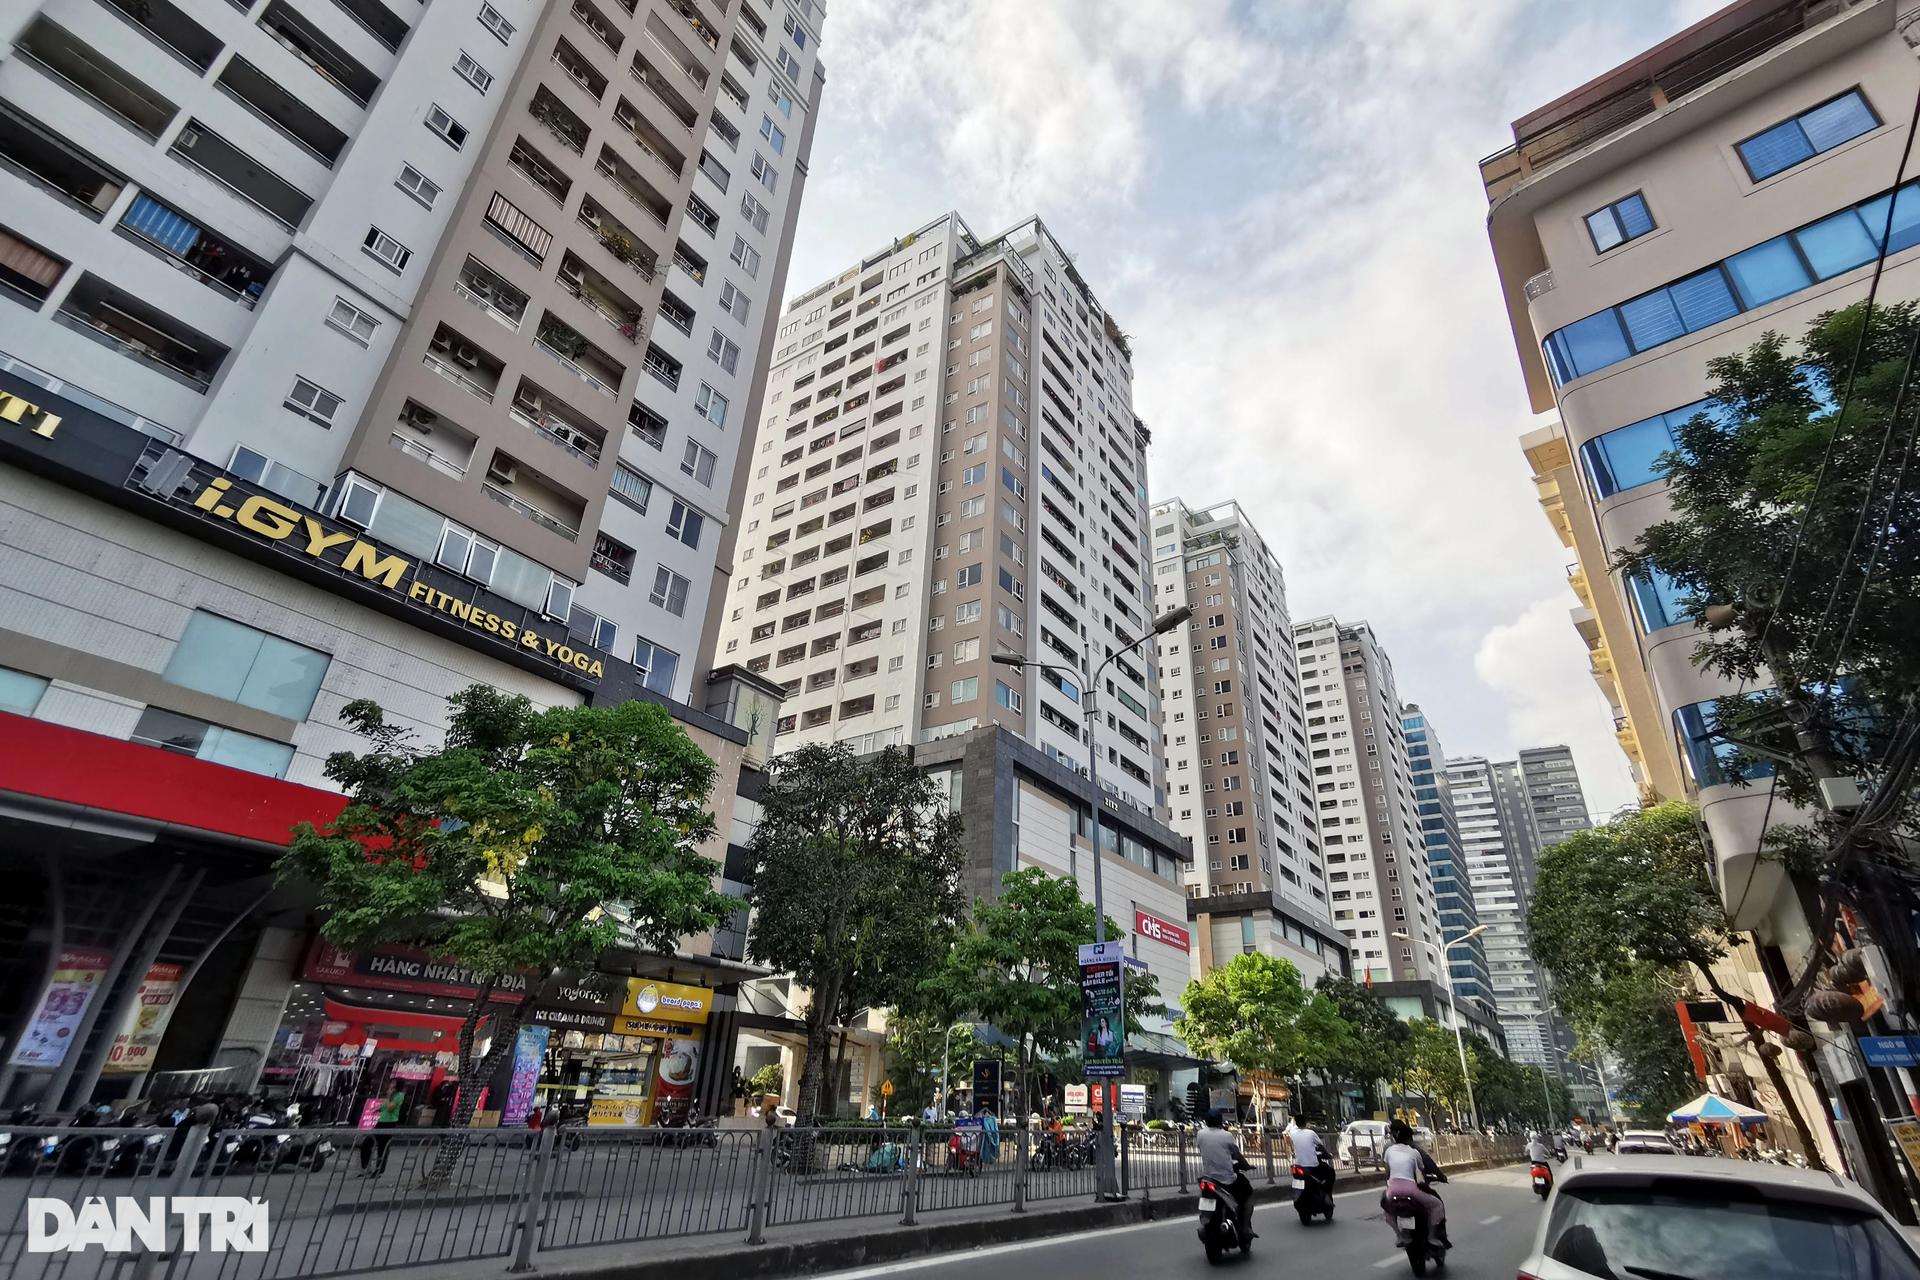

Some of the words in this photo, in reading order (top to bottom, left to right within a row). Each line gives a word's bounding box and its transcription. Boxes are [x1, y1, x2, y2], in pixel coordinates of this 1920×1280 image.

[194, 477, 409, 590] i.GYM
[409, 581, 518, 640] FITNESS
[521, 630, 540, 651] &
[545, 638, 604, 679] YOGA
[370, 955, 420, 977] HÀNG
[423, 964, 469, 985] NHẬT
[501, 974, 526, 992] ĐỊA
[535, 1009, 549, 1021] ICE
[548, 1011, 574, 1023] CREAM
[580, 1015, 606, 1027] DRINKS
[661, 995, 681, 1006] beard
[681, 999, 703, 1009] papa's
